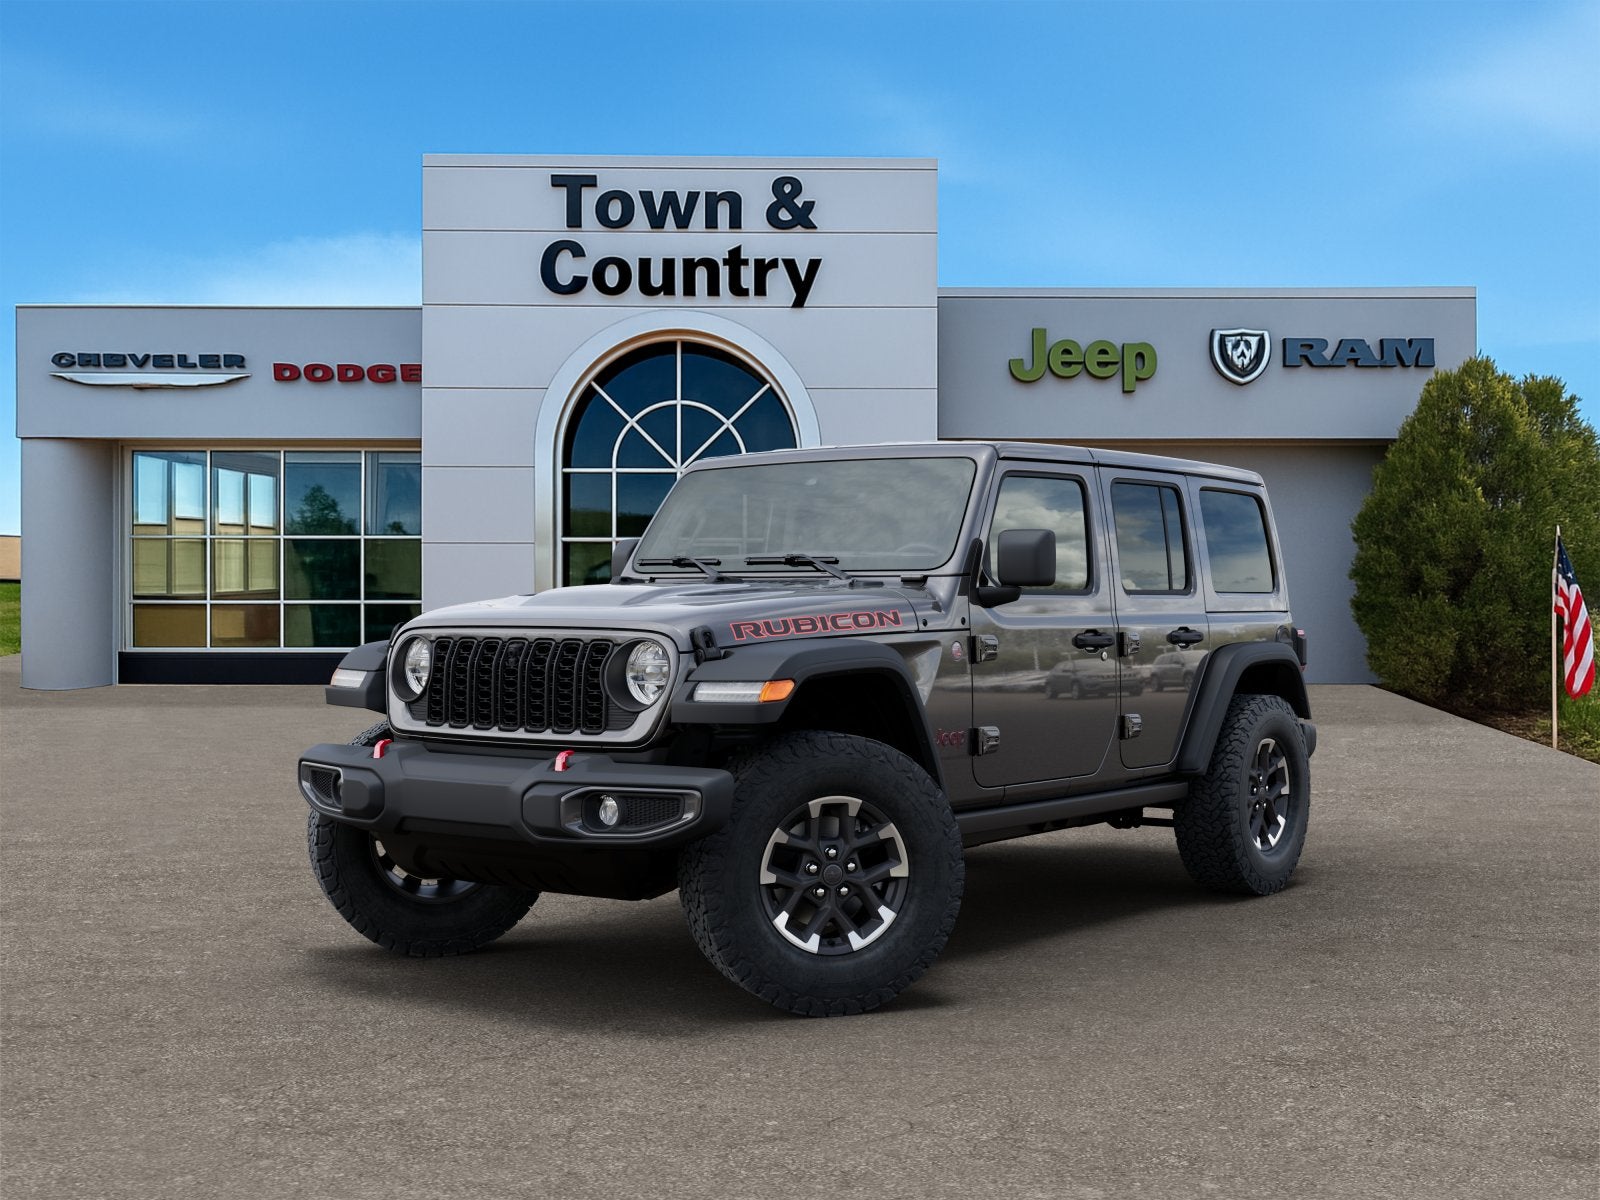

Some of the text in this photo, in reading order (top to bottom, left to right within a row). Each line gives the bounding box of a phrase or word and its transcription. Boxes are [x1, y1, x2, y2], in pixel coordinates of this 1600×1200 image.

[550, 174, 818, 230] Town &
[540, 239, 822, 308] Country
[273, 363, 422, 383] DODGE
[1009, 328, 1157, 393] Jeep
[1282, 338, 1435, 368] RAM
[730, 609, 903, 641] RUBICON
